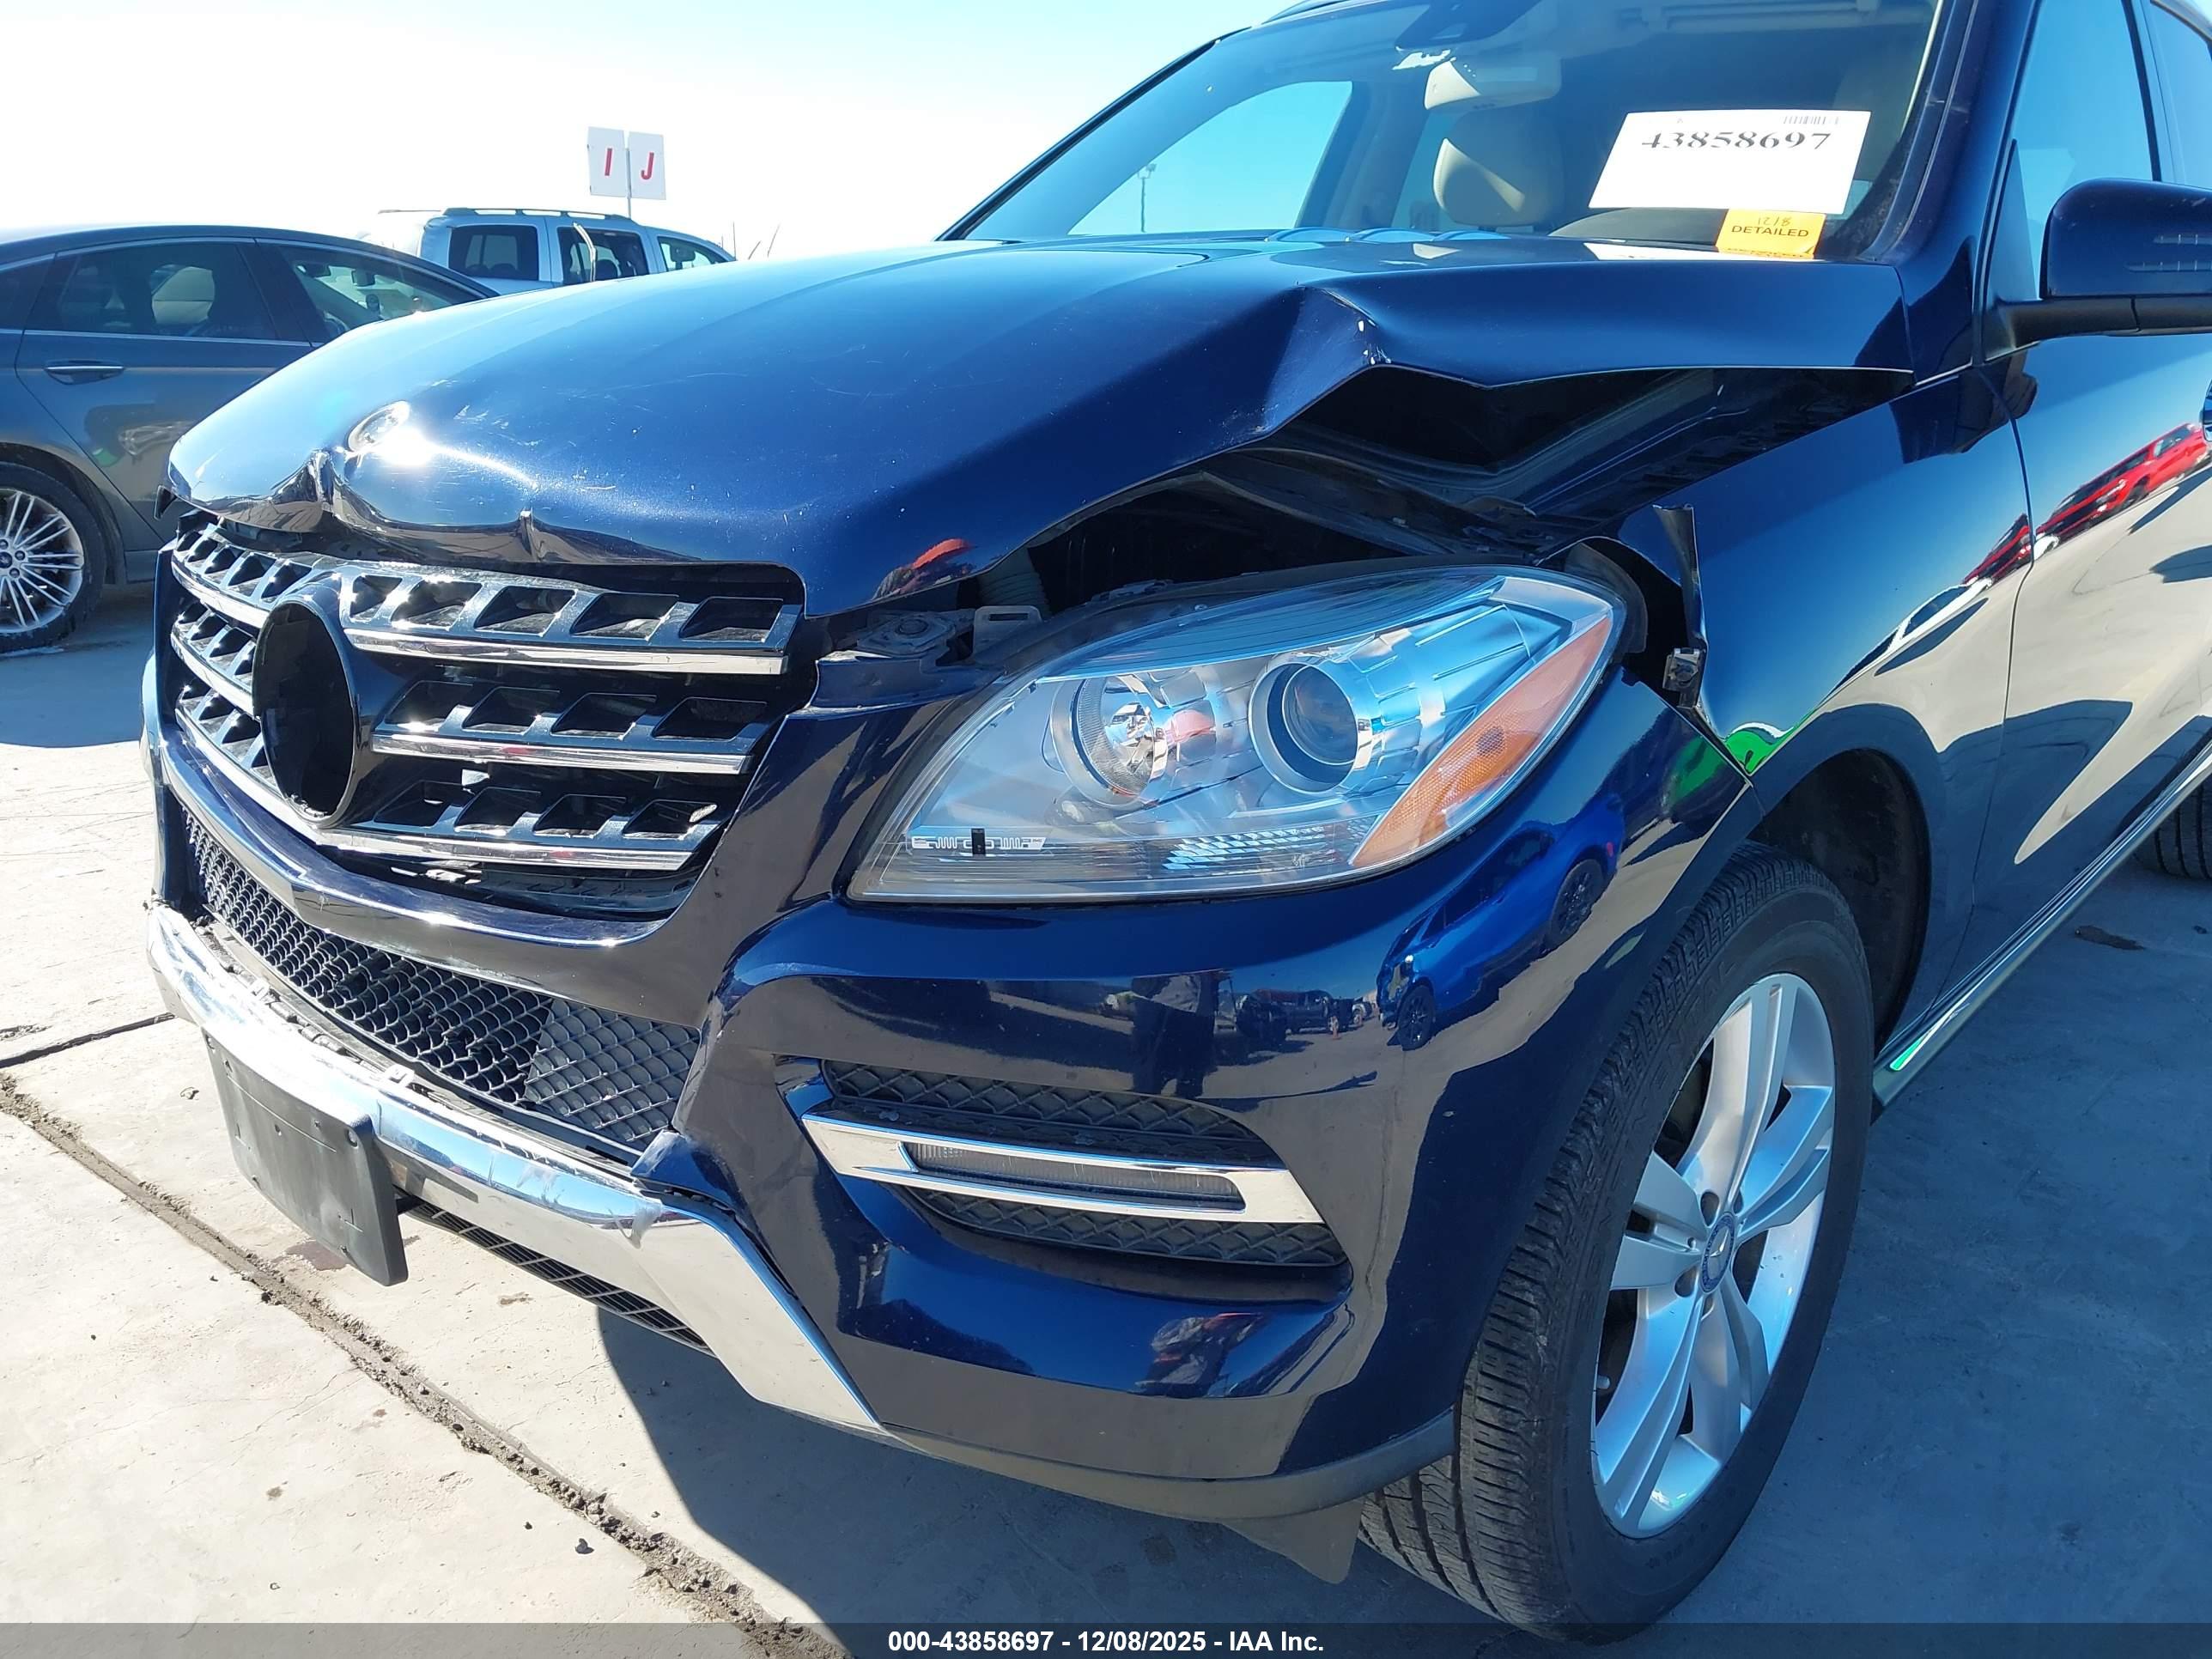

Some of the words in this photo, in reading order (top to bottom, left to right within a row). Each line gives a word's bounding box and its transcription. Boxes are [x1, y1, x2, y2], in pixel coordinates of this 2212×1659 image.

[1641, 131, 1832, 149] 43858697
[604, 148, 613, 176] I
[641, 152, 654, 180] J
[1731, 225, 1809, 237] DETAILED
